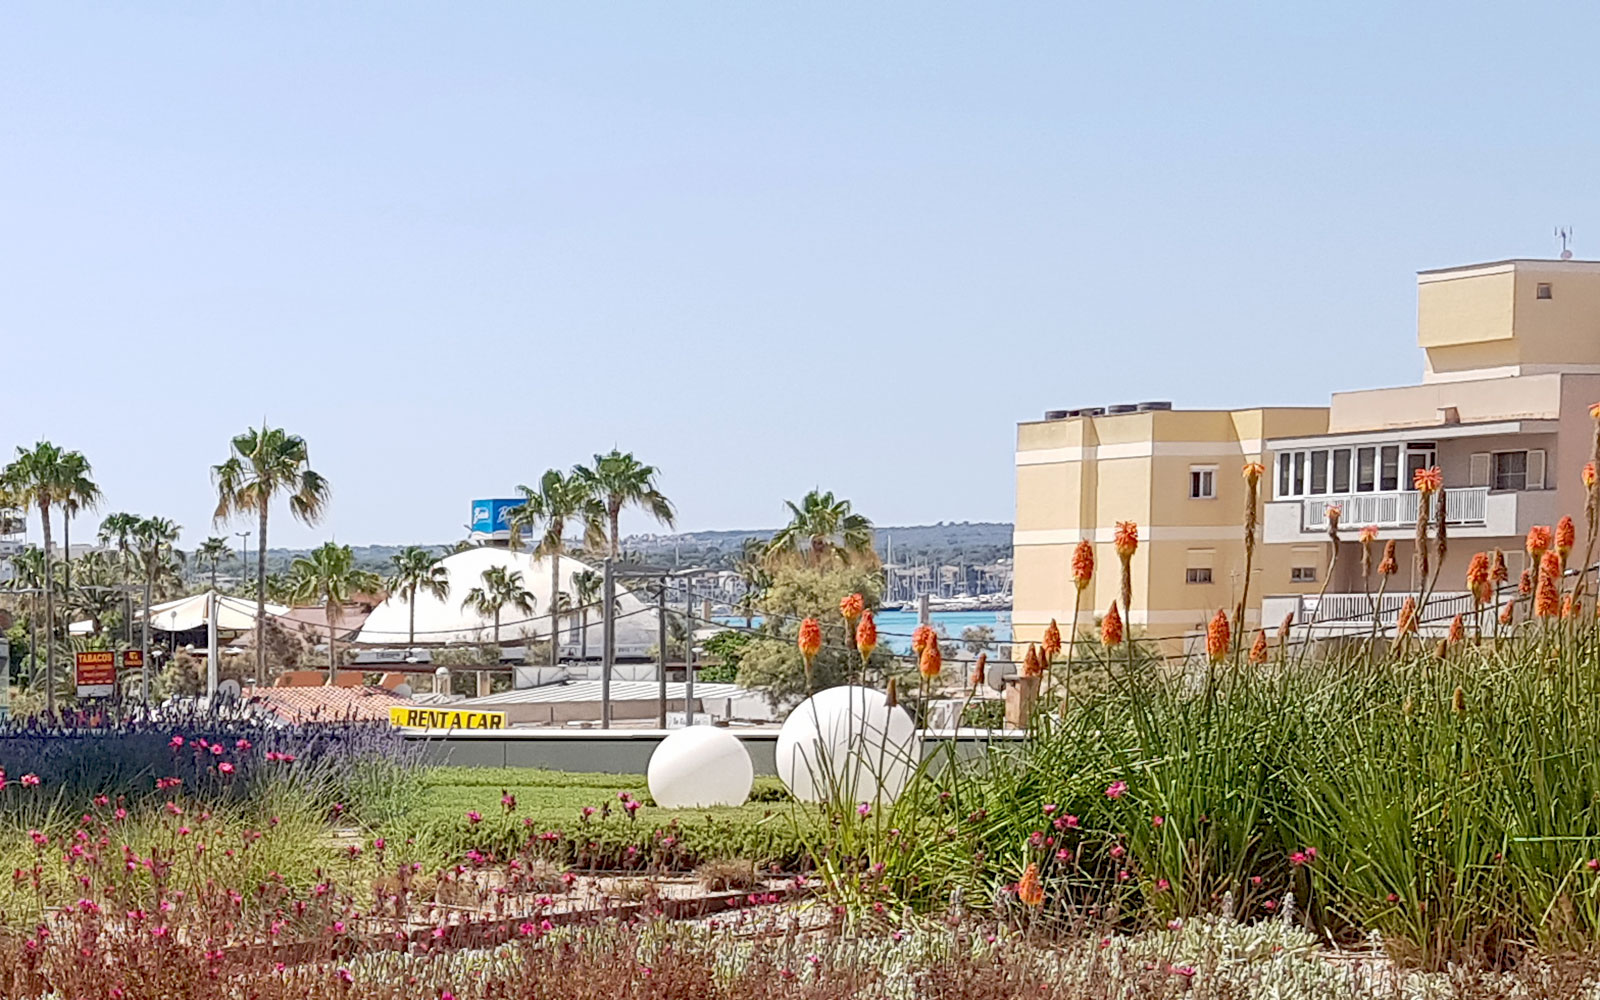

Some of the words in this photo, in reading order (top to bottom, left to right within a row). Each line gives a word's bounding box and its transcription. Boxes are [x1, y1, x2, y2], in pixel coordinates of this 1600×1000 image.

[78, 653, 112, 663] TABACOS
[407, 709, 449, 729] RENT
[451, 713, 462, 729] A
[467, 713, 502, 729] CAR
